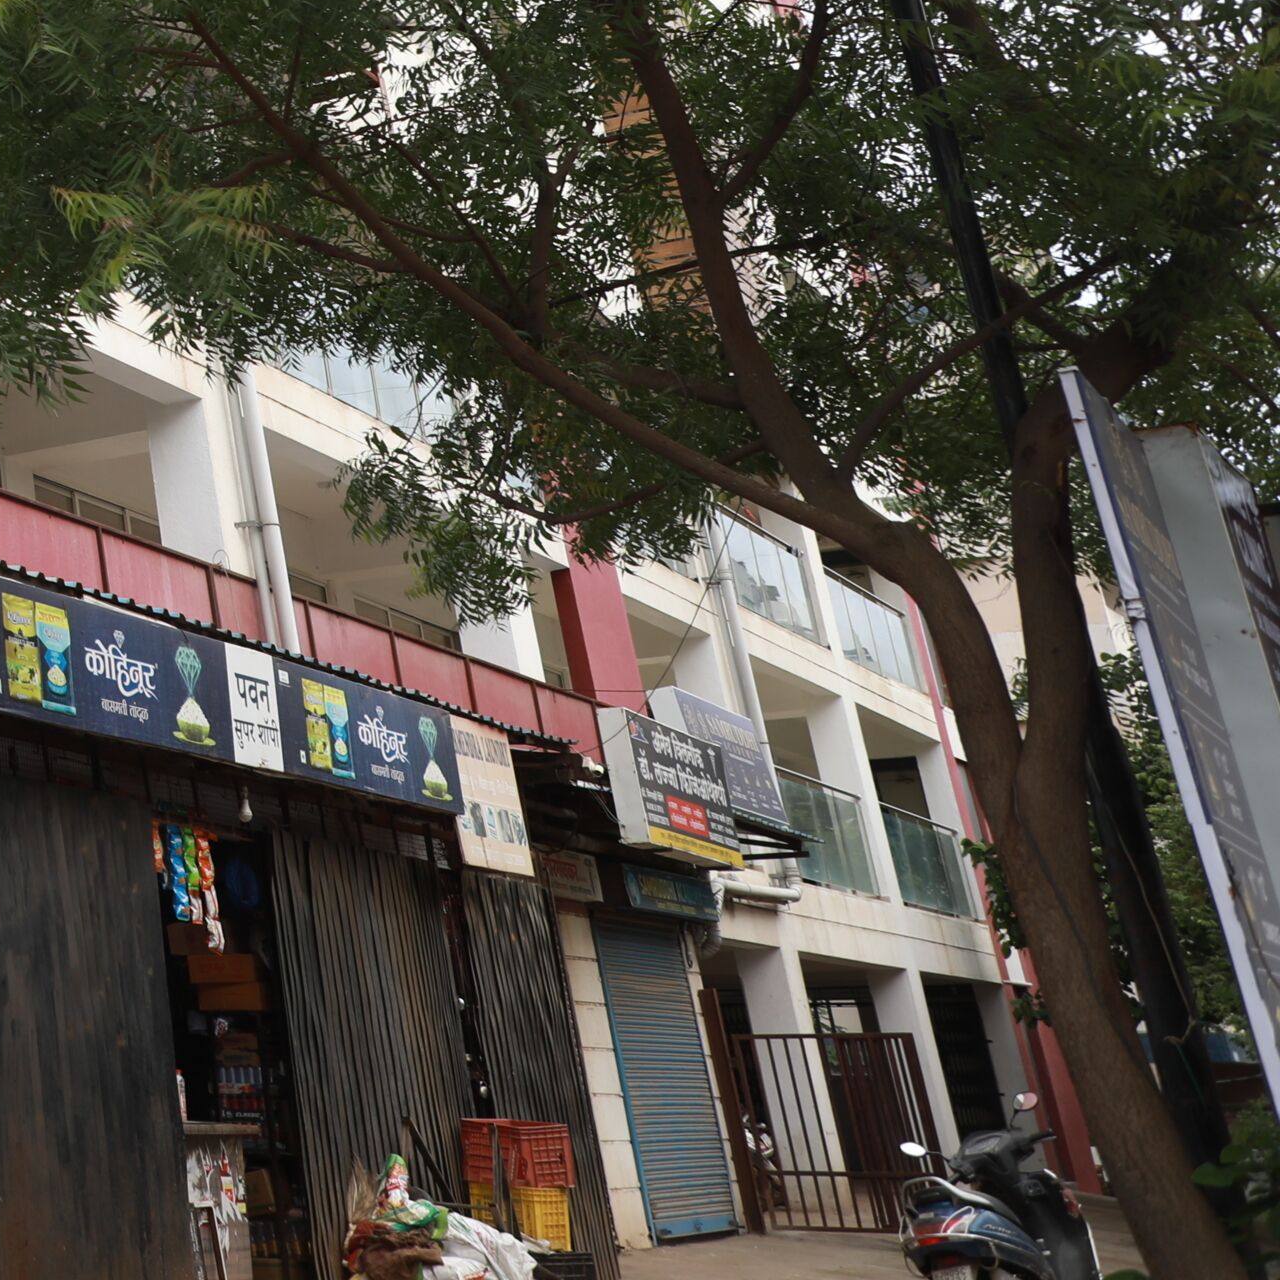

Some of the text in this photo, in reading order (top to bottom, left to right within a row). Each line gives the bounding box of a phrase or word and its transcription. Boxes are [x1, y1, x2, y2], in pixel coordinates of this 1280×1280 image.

[84, 639, 158, 700] कोहिनूर
[235, 673, 271, 714] पवन
[234, 717, 280, 750] सुपर शॉपी
[357, 714, 409, 764] कोहिनूर
